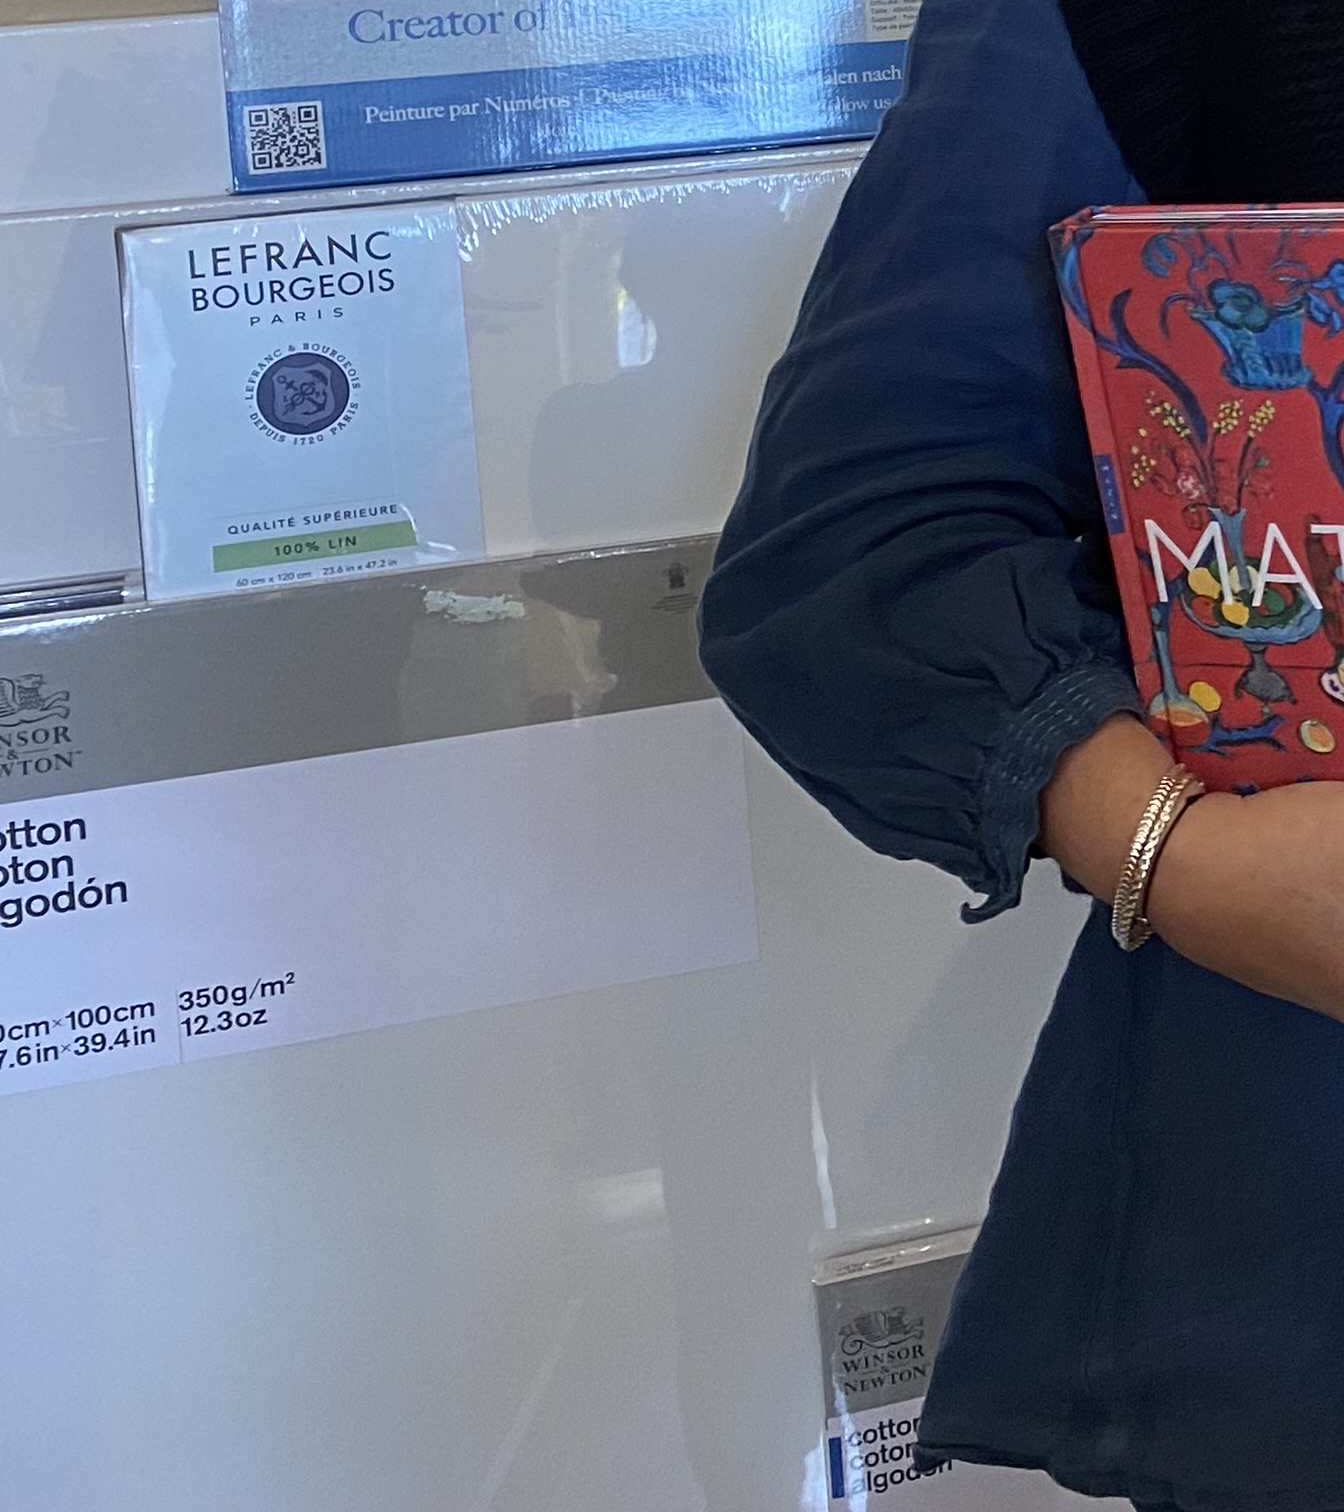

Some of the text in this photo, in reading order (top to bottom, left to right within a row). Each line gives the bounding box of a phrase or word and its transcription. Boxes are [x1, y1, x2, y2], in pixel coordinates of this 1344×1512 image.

[347, 2, 549, 44] Creator of
[362, 92, 572, 126] Peinture par Numéros
[188, 230, 393, 280] LEFRANC
[190, 267, 396, 313] BOURGEOIS
[248, 306, 345, 328] PARIS
[244, 347, 282, 401] LEFRANC
[302, 342, 362, 391] BOURGEOIS
[248, 401, 360, 447] DEPUIS 1720 PARIS
[227, 503, 399, 536] QUALITÉ SUPÉRIEURE
[274, 534, 358, 558] 100% LIN
[180, 1008, 268, 1039] 12.3oz
[841, 1342, 926, 1374] WINSOR
[844, 1364, 928, 1396] NEWTON
